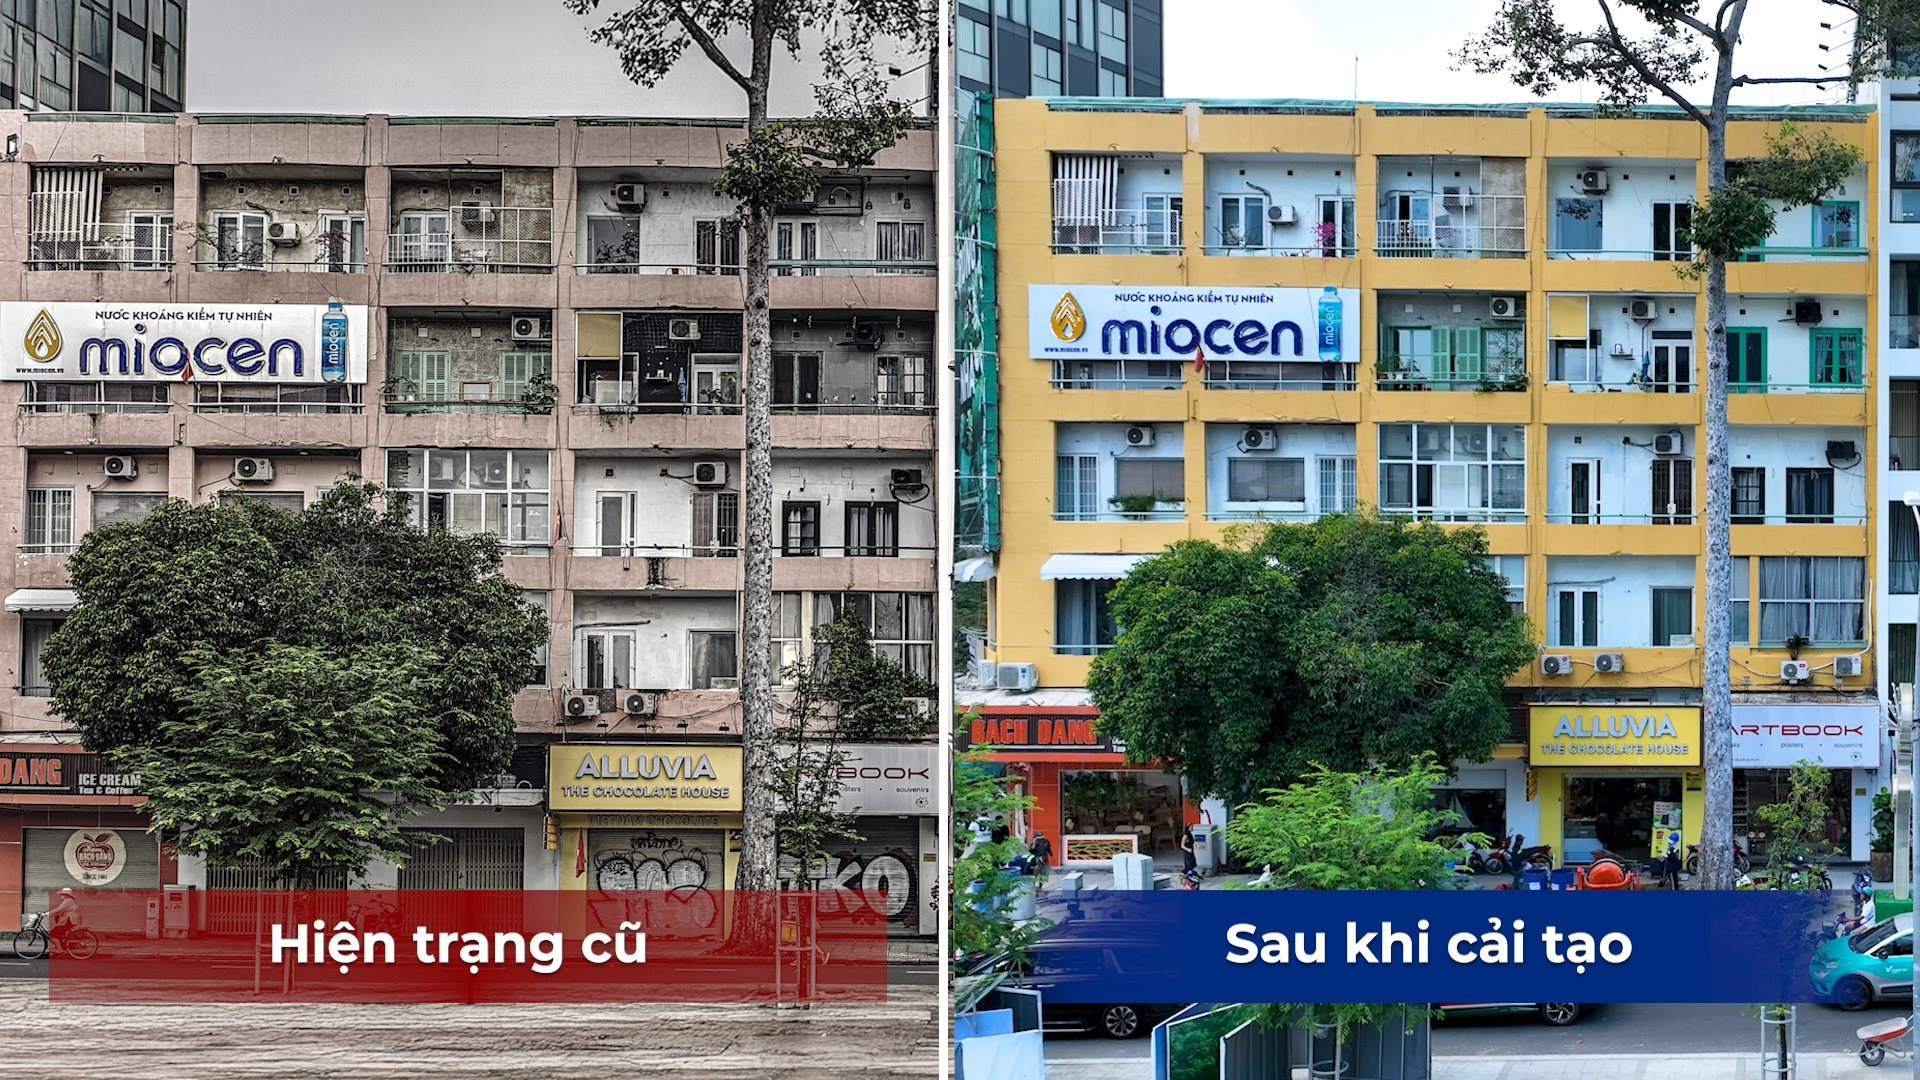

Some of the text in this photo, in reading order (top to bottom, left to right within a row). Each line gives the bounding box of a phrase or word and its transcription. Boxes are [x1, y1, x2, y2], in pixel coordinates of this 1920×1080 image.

[1149, 291, 1195, 303] KHOÁNG
[1225, 294, 1239, 305] TỰ
[1241, 293, 1274, 303] NHIÊN
[132, 308, 184, 321] KHOÁNG
[218, 311, 234, 323] TỰ
[236, 309, 273, 321] NHIÊN
[1101, 306, 1304, 356] miocen
[1323, 305, 1335, 345] miocen
[79, 323, 304, 377] miocen
[326, 322, 340, 364] miocen
[971, 719, 1097, 745] BACH DANG
[1553, 713, 1677, 738] ALLUVIA
[1541, 743, 1689, 755] THE CHOCOLATE HOUSE
[575, 752, 717, 779] ALLUVIA
[79, 773, 142, 786] ICE CREAM
[79, 786, 135, 795] Tea & Coffee
[562, 785, 730, 798] THE CHOCOLATE HOUSE
[895, 785, 930, 793] souvenirs
[647, 815, 719, 826] CHOCOLATE
